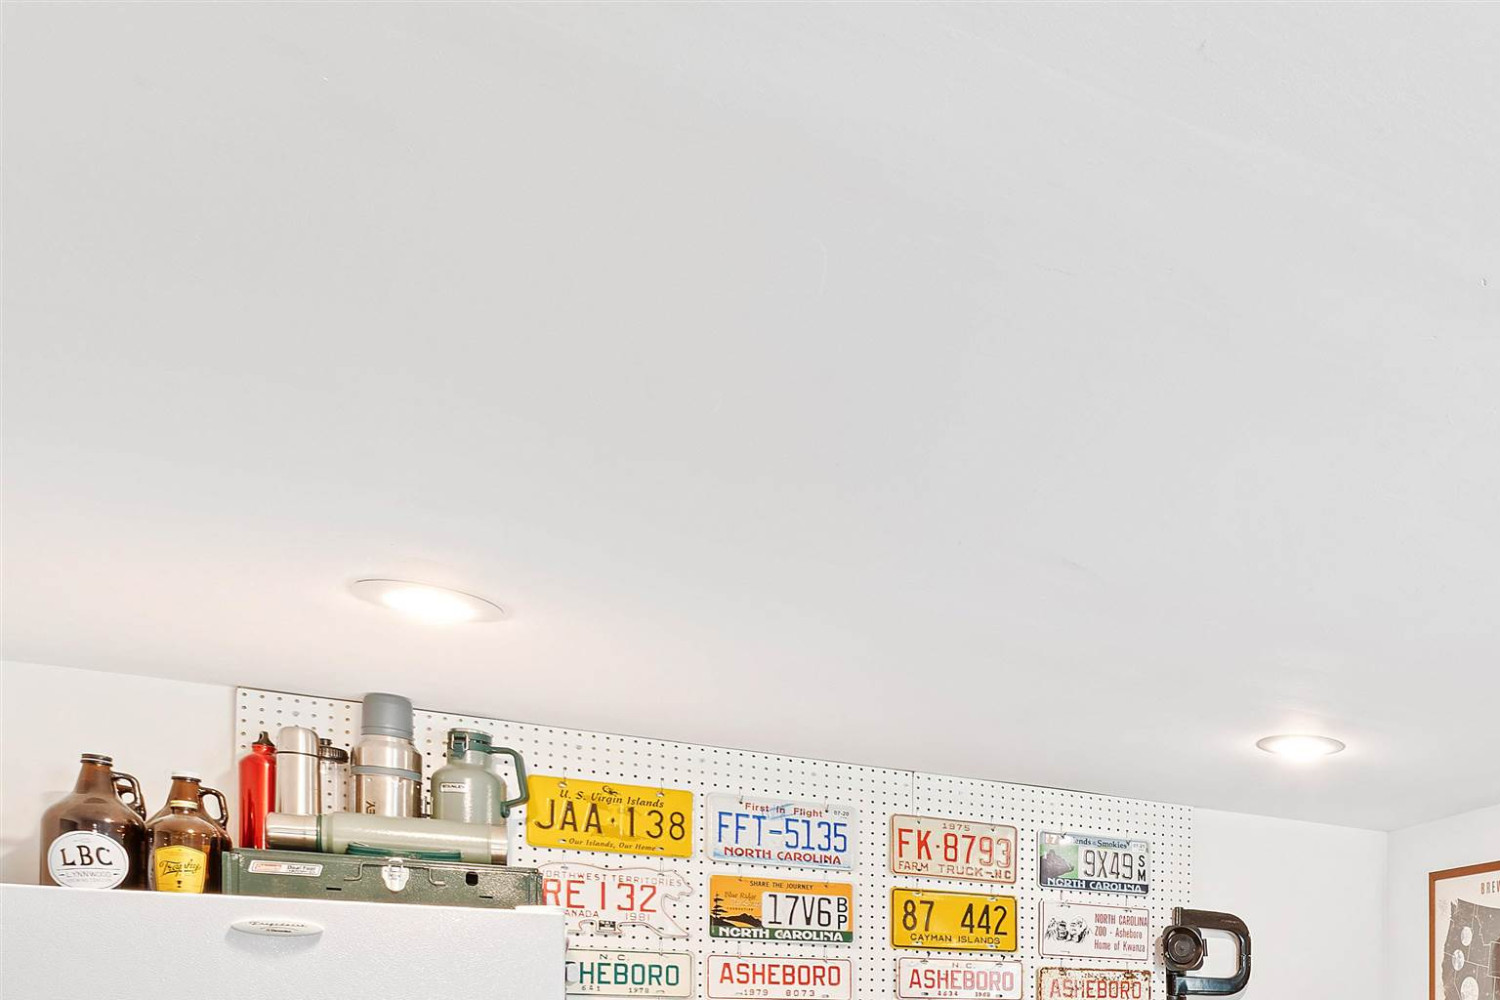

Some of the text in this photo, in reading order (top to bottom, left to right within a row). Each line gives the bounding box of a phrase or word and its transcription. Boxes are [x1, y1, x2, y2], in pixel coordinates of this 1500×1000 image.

[592, 792, 622, 805] Virgin
[627, 797, 664, 808] Islands
[745, 802, 770, 812] First
[794, 808, 822, 818] Flight
[718, 812, 847, 852] FFT-5135
[942, 822, 970, 832] 1975
[568, 838, 583, 846] Our
[618, 842, 632, 850] Our
[1097, 840, 1128, 849] Smokies
[60, 844, 113, 866] LBC
[724, 846, 842, 864] NORTH CAROLINA
[898, 861, 929, 871] FARM
[1084, 850, 1133, 880] 9X49
[542, 870, 682, 886] ORTHWEST TERRITORIES
[750, 880, 769, 888] SHARE
[786, 882, 814, 890] JOURNEY
[1048, 878, 1142, 892] NORTH CAROLINA
[564, 910, 599, 918] ANADA
[768, 894, 832, 927] 17V6
[902, 900, 1008, 936] 87 442
[1094, 914, 1148, 926] NORTH CAROLINA
[720, 926, 844, 942] NORTH CAROLINA
[910, 933, 1001, 944] CAYMAN ISLANDS
[1094, 926, 1107, 937] ZOO
[1115, 928, 1142, 939] Asheboro
[1094, 940, 1146, 952] Home of Kwanza
[579, 962, 680, 986] HEBORO
[720, 962, 840, 986] ASHEBORO
[909, 968, 1014, 992] ASHEBORO
[744, 988, 769, 996] 1979
[1050, 979, 1141, 999] ASHEBORO
